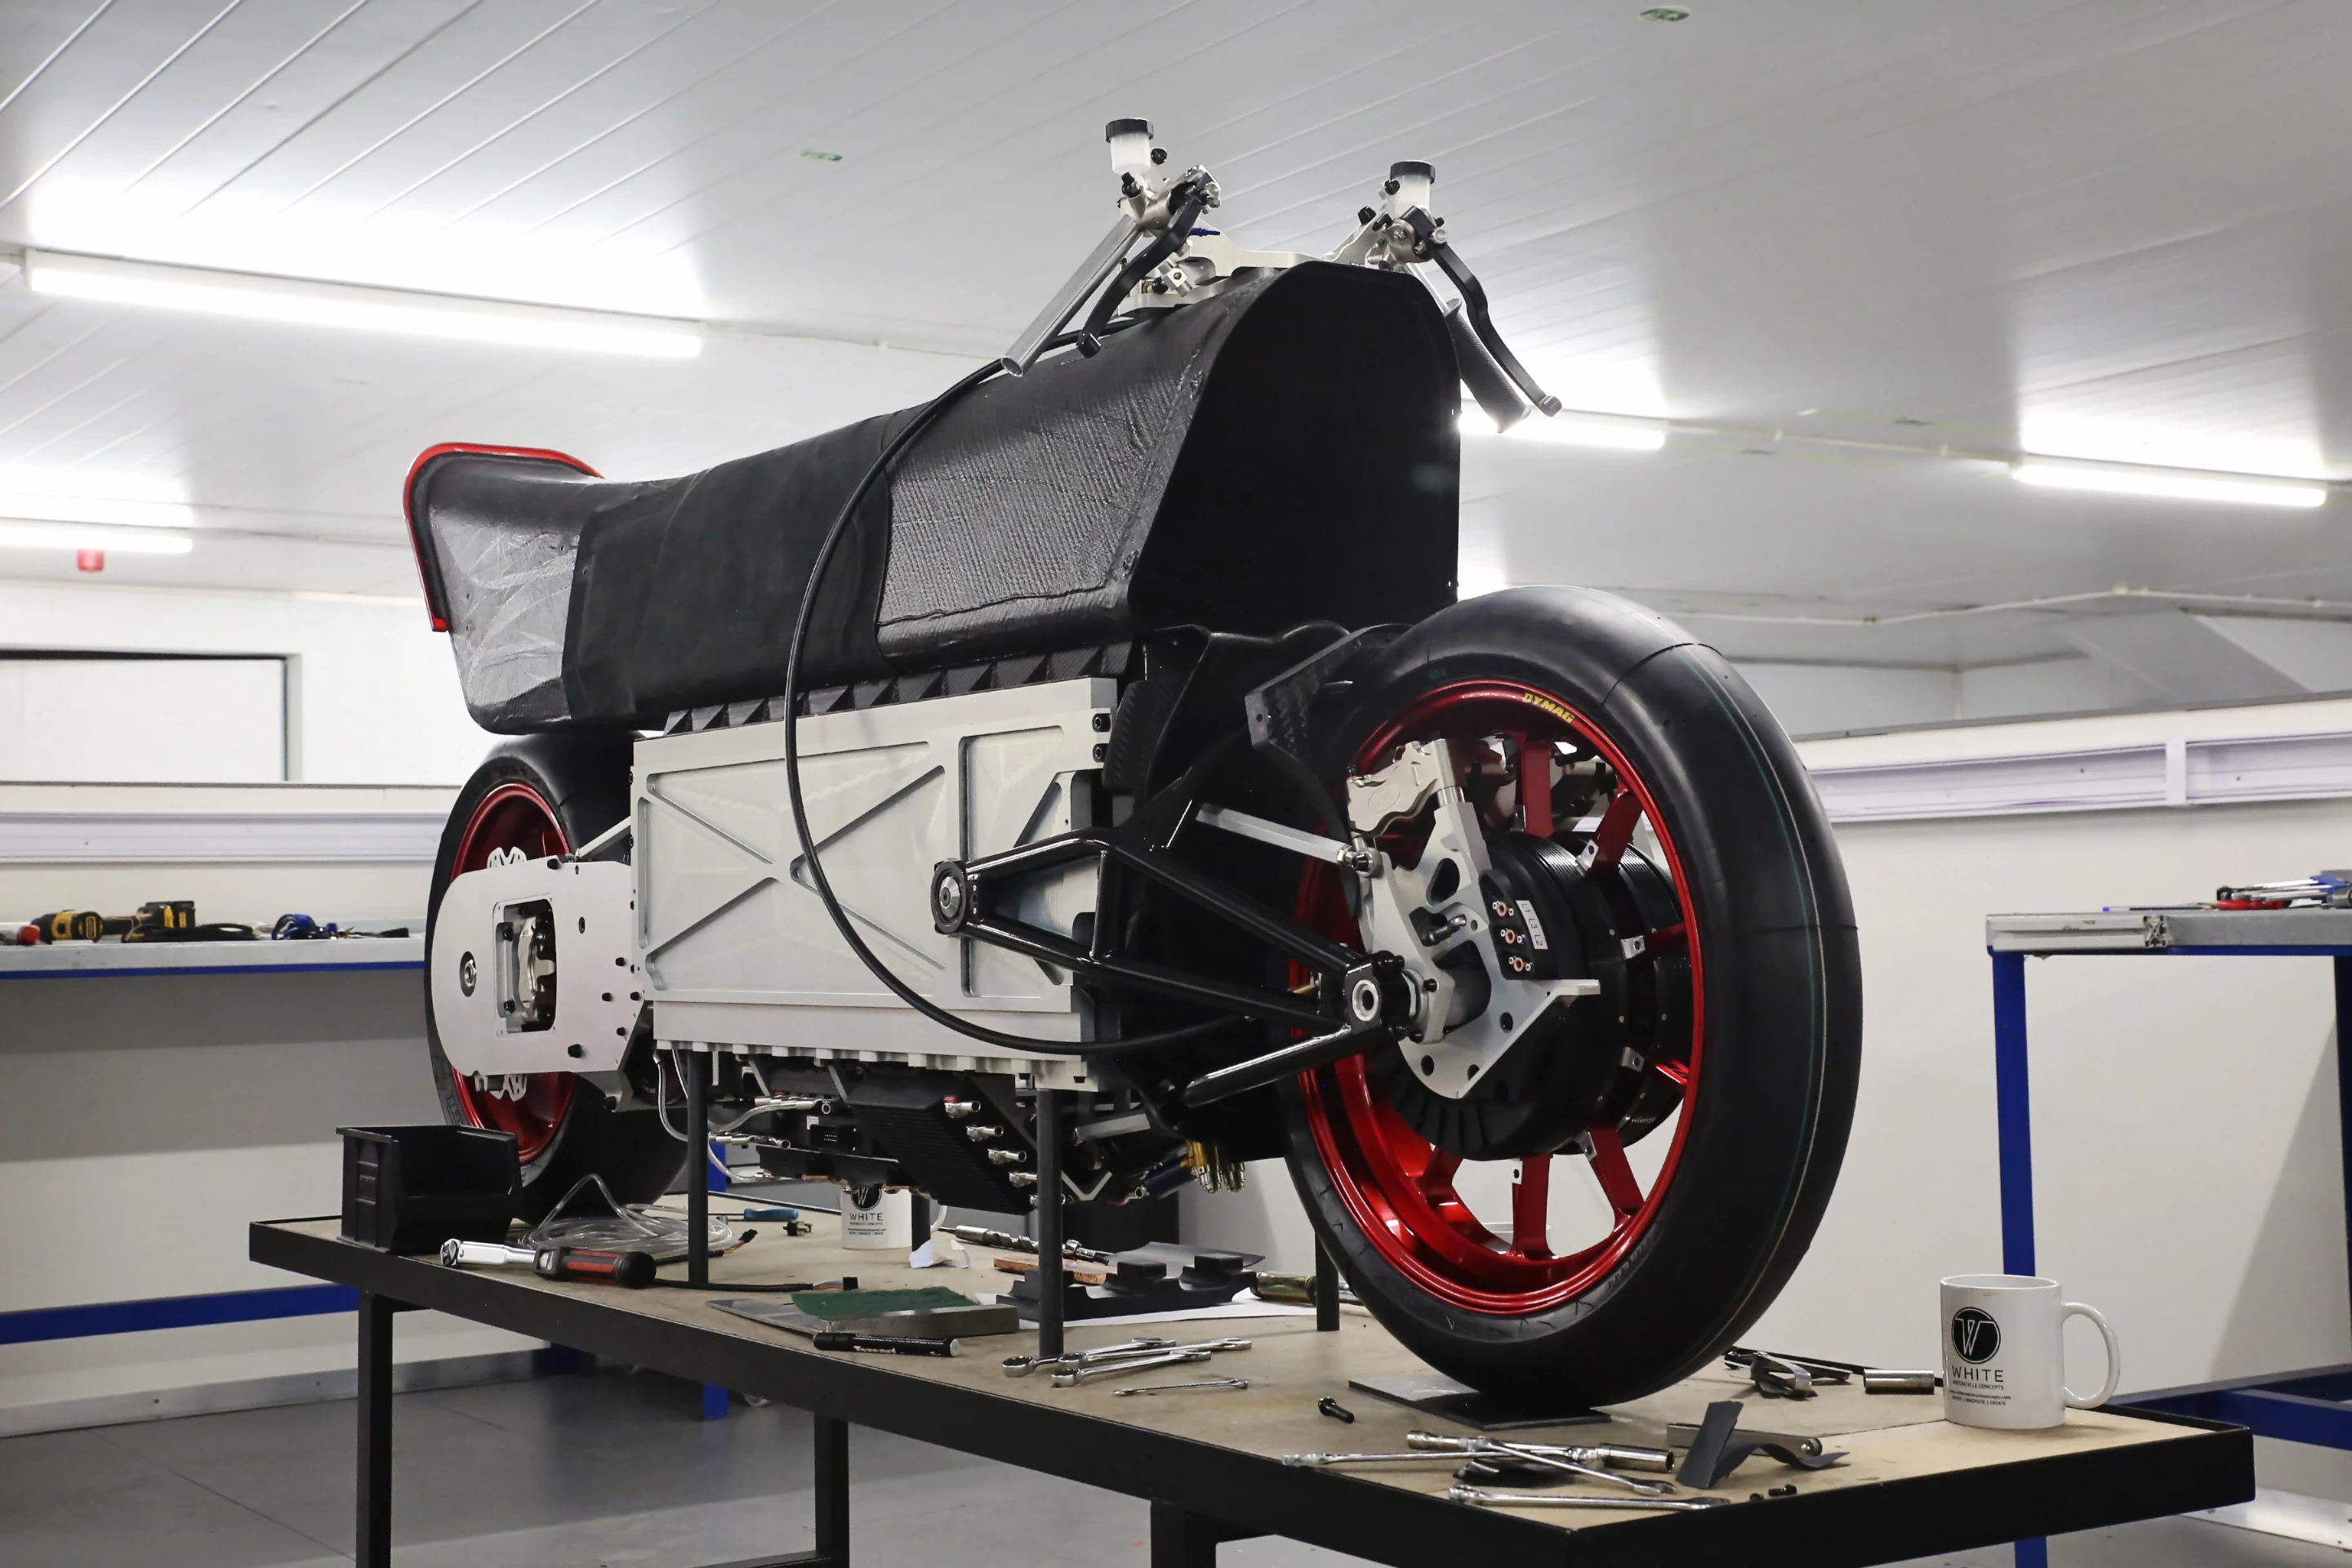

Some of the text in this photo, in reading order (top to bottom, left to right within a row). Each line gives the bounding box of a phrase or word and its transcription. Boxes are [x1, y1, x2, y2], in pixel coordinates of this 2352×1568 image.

[1522, 693, 1575, 724] DYMAG
[1521, 903, 1544, 946] L1 L3 L2
[849, 1213, 883, 1221] WHITE
[1951, 1365, 2004, 1383] WHITE
